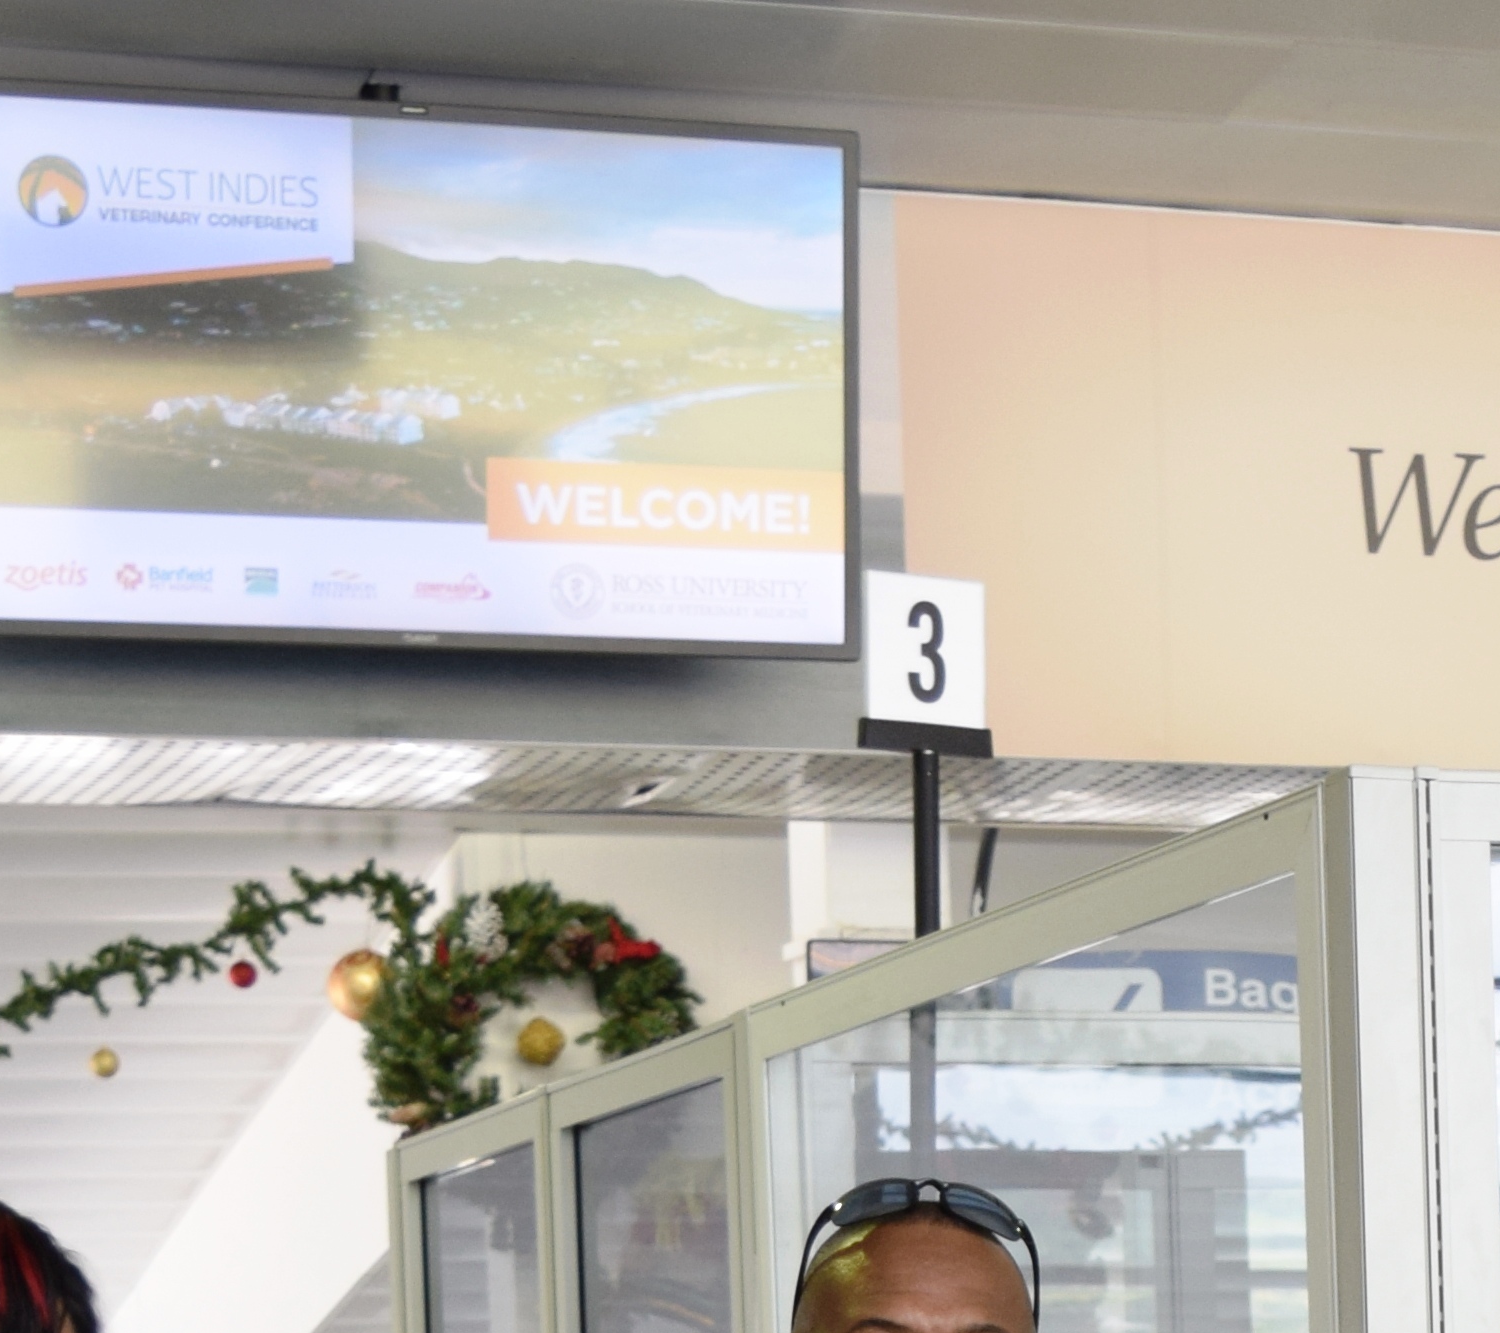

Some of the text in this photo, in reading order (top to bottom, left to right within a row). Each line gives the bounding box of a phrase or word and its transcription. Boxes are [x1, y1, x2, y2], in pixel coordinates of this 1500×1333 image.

[96, 164, 320, 208] WEST INDIES
[98, 206, 320, 232] VETERINARY CONFERENCE
[516, 482, 810, 535] WELCOME!
[4, 560, 89, 591] zoetis
[611, 574, 809, 600] ROSS UNIVERSITY
[907, 600, 946, 703] 3
